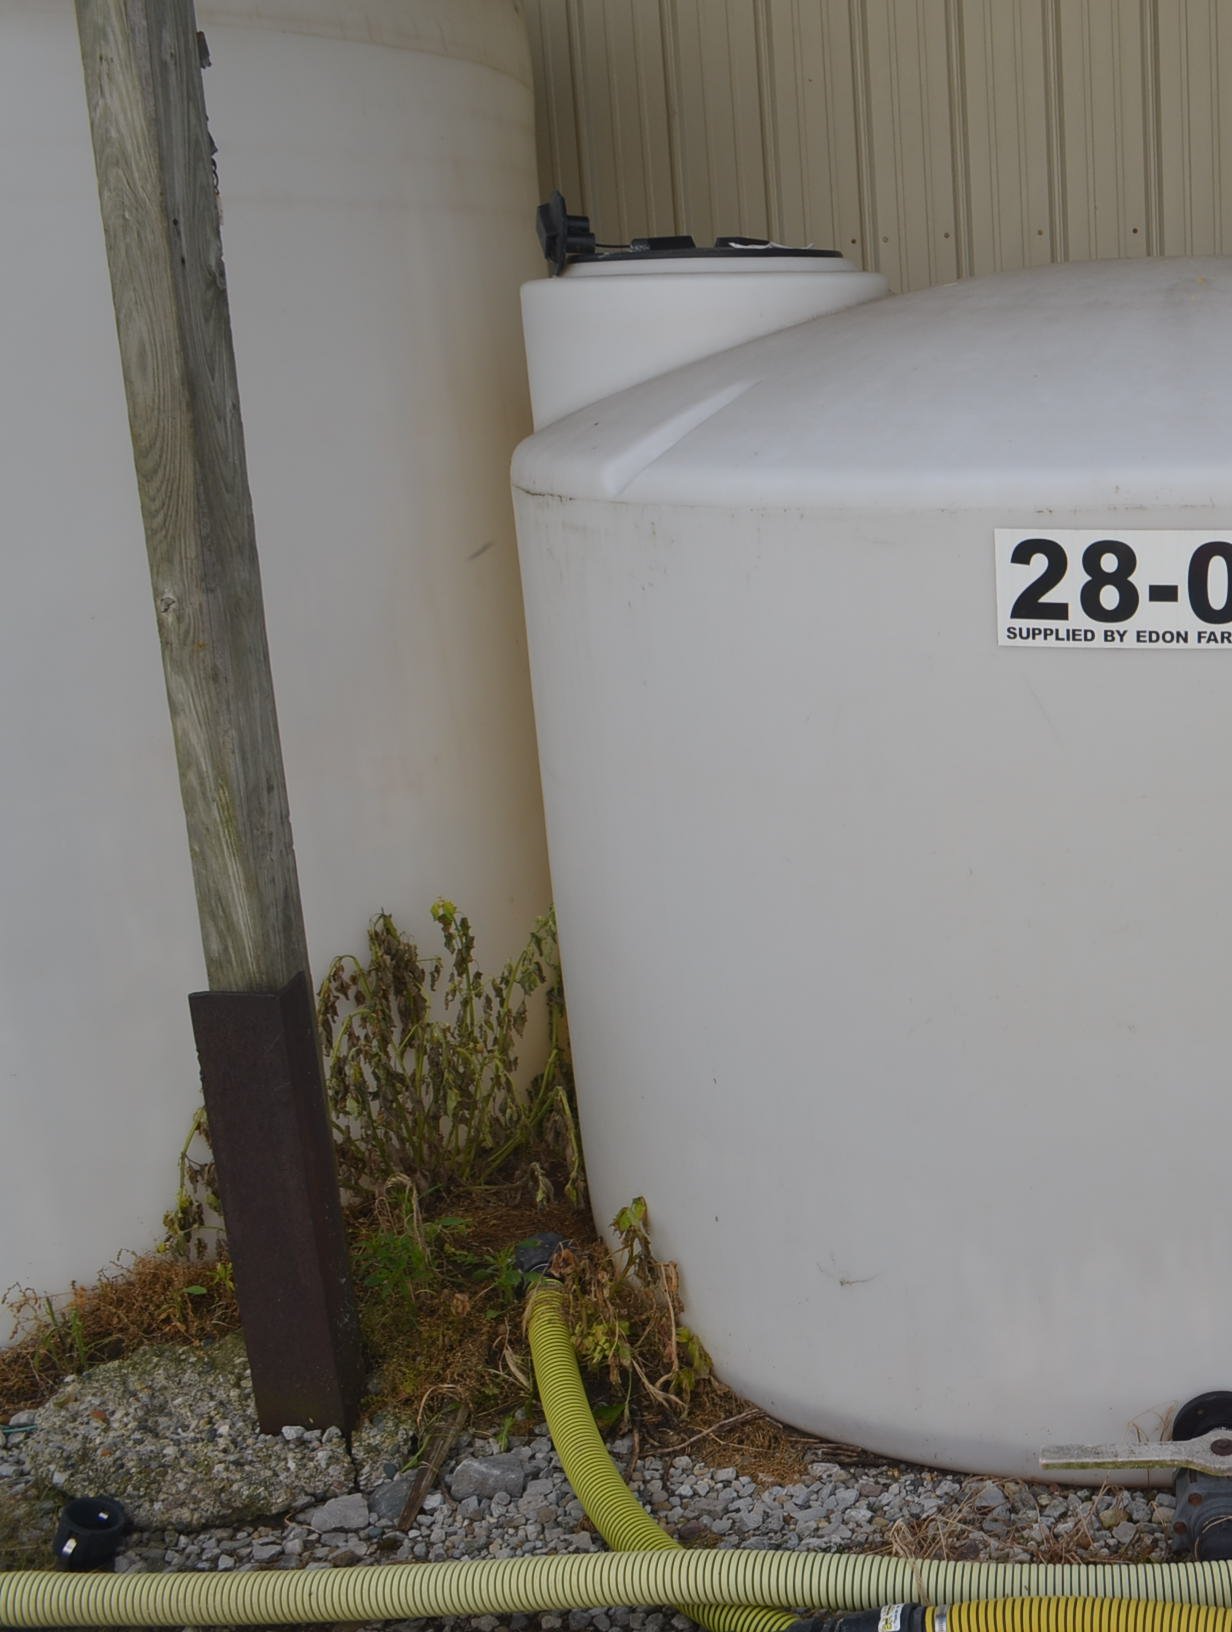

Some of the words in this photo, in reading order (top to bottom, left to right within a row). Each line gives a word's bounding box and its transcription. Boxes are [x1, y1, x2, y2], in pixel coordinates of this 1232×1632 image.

[1007, 627, 1095, 641] SUPPLIED
[1104, 630, 1127, 642] BY
[1136, 631, 1188, 643] EDON
